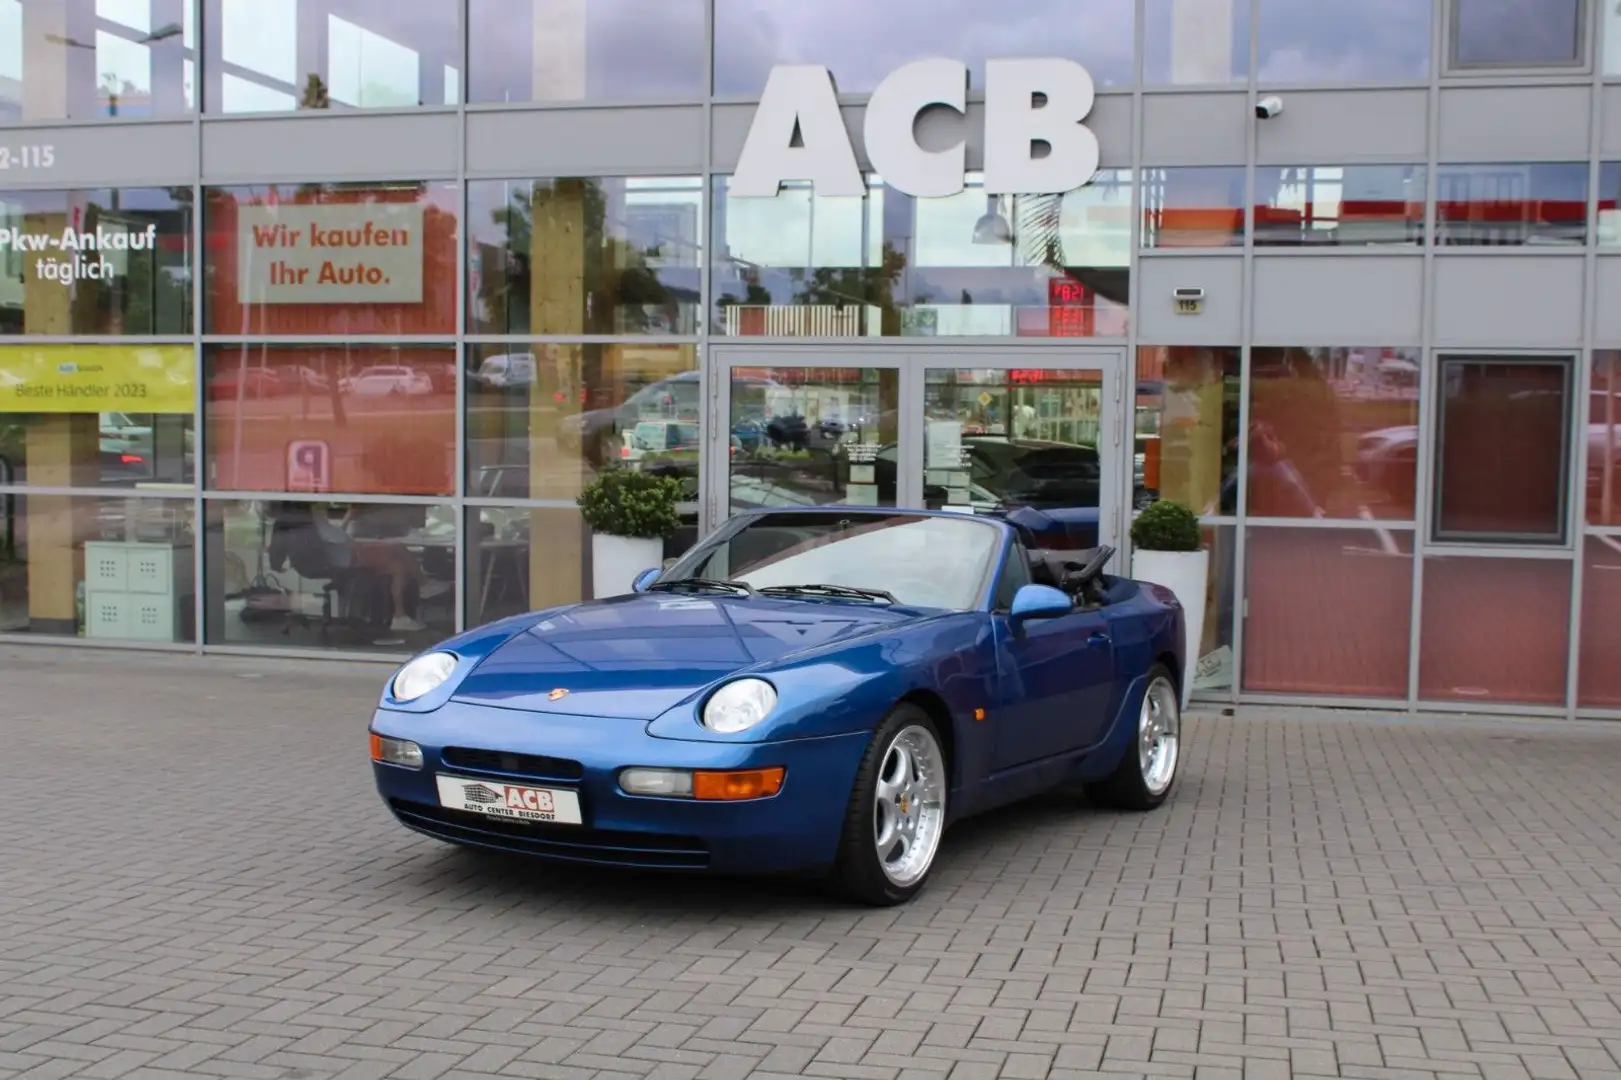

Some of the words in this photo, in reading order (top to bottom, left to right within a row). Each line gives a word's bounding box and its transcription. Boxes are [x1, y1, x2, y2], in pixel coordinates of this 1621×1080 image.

[728, 57, 1099, 198] ACB
[0, 224, 156, 251] Pkw-Ankauf
[253, 224, 300, 248] Wir
[310, 222, 408, 247] kaufen
[36, 255, 114, 285] täglich
[270, 261, 309, 285] Ihr
[317, 260, 391, 285] Auto.
[1178, 299, 1197, 311] 115
[16, 384, 53, 397] Beste
[57, 383, 109, 397] Händler
[114, 384, 147, 397] 2023
[464, 803, 483, 812] AUTO
[487, 806, 514, 816] CENTER
[518, 811, 555, 820] BIESDORF
[505, 787, 554, 811] ACB
